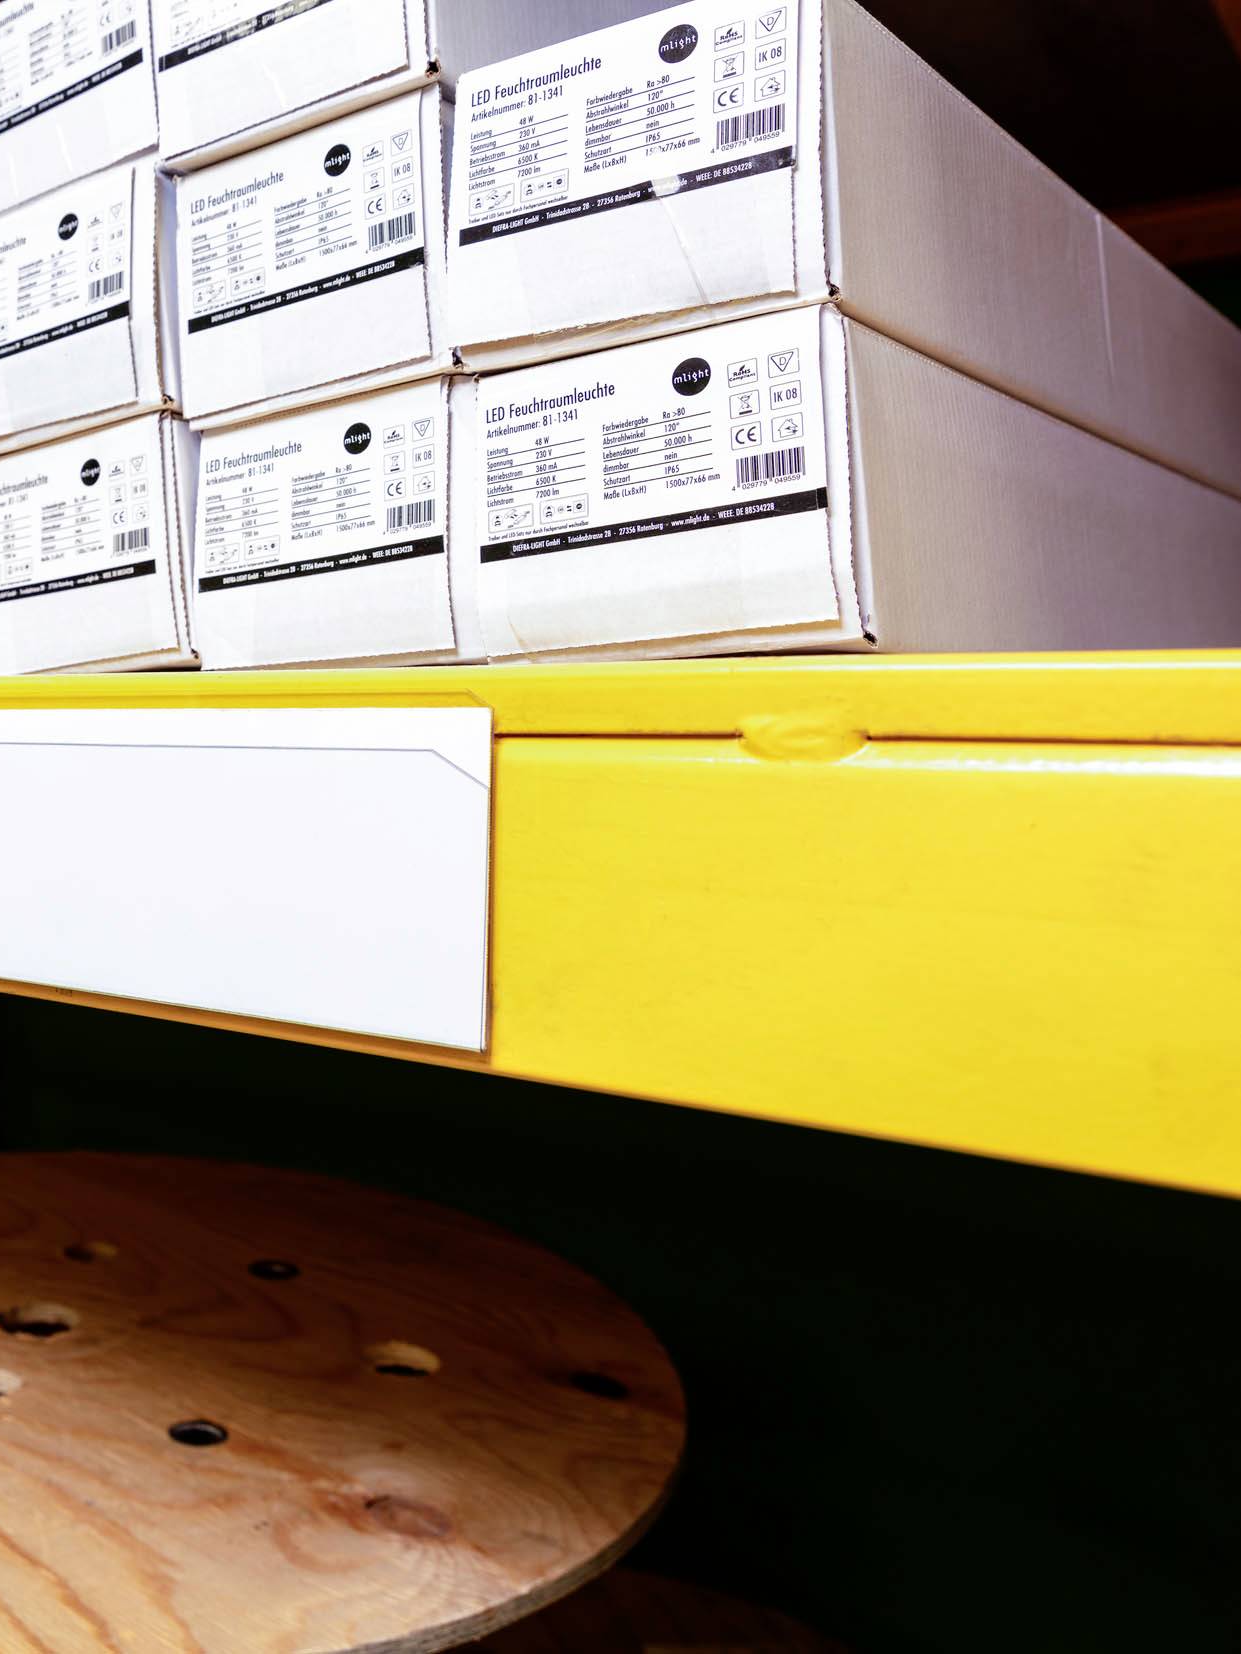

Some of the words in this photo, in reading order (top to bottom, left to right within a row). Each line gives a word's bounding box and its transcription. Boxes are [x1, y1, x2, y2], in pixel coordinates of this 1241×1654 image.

[661, 35, 696, 52] mlight
[759, 51, 768, 62] IK
[771, 46, 782, 59] 08
[472, 89, 490, 107] LED
[495, 57, 601, 100] Feuchtraumleuchte
[587, 87, 633, 106] Farbwiedergabe
[657, 75, 669, 85] >80
[528, 85, 562, 105] 81-1341
[718, 88, 738, 106] CE
[586, 100, 628, 119] Abstrahlwinkel
[586, 118, 621, 133] Lebensdauer
[647, 103, 668, 115] 50.000
[471, 130, 492, 140] Leistung
[471, 141, 496, 152] Spannung
[520, 129, 530, 138] 230
[585, 134, 611, 146] dimmbar
[646, 120, 659, 129] nein
[721, 140, 746, 151] 029779
[754, 131, 779, 143] 049559
[470, 152, 505, 165] Betriebsstrom
[519, 143, 529, 152] 360
[531, 140, 540, 148] mA
[585, 147, 611, 159] Schutzart
[646, 132, 660, 142] IP65
[469, 166, 495, 178] Lichtfarbe
[518, 154, 532, 165] 6500
[584, 163, 600, 173] Maße
[469, 180, 495, 190] Lichtstrom
[518, 167, 532, 177] 7200
[191, 199, 204, 214] LED
[208, 171, 283, 208] Feuchtraumleuchte
[525, 215, 539, 224] GmbH
[597, 197, 614, 206] 27356
[696, 172, 712, 182] WEEE:
[714, 169, 722, 178] DE
[723, 159, 753, 175] 88534228
[674, 369, 709, 384] mlight
[487, 407, 504, 423] LED
[510, 382, 614, 418] Feuchtraumleuchte
[774, 392, 783, 402] IK
[786, 388, 797, 400] 08
[487, 422, 540, 438] Artikelnummer:
[543, 409, 577, 426] 81-1341
[603, 416, 648, 432] Farbwiedergabe
[673, 407, 685, 417] >80
[345, 433, 370, 444] mlight
[603, 429, 645, 445] Abstrahlwinkel
[735, 426, 756, 444] CE
[206, 459, 220, 473] LED
[224, 441, 301, 469] Feuchtraumleuchte
[415, 453, 422, 462] IK
[424, 451, 432, 460] 08
[487, 448, 508, 456] Leistung
[535, 438, 543, 446] 48
[603, 448, 639, 459] Lebensdauer
[665, 436, 686, 447] 50.000
[487, 459, 513, 469] Spannung
[536, 450, 546, 459] 230
[603, 462, 629, 472] dimmbar
[665, 452, 677, 460] nein
[487, 471, 522, 482] Betriebsstrom
[536, 464, 546, 472] 360
[603, 475, 630, 486] Schutzart
[665, 465, 679, 474] IP65
[742, 480, 767, 490] 029779
[775, 474, 800, 484] 049559
[387, 482, 402, 496] CE
[487, 484, 512, 495] Lichtfarbe
[536, 476, 550, 485] 6500
[604, 490, 619, 499] Maße
[666, 475, 706, 488] 1500x77x66
[487, 498, 513, 507] Lichtstrom
[536, 489, 550, 498] 7200
[513, 541, 545, 552] DIEFRA-LIGHT
[546, 538, 560, 547] GmbH
[568, 533, 603, 543] Trinidadstrasse
[619, 526, 636, 535] 27356
[637, 523, 663, 532] Rotenburg
[671, 513, 709, 526] www.mlight.de
[718, 510, 734, 518] WEEE:
[736, 507, 744, 516] DE
[745, 503, 774, 514] 88534228
